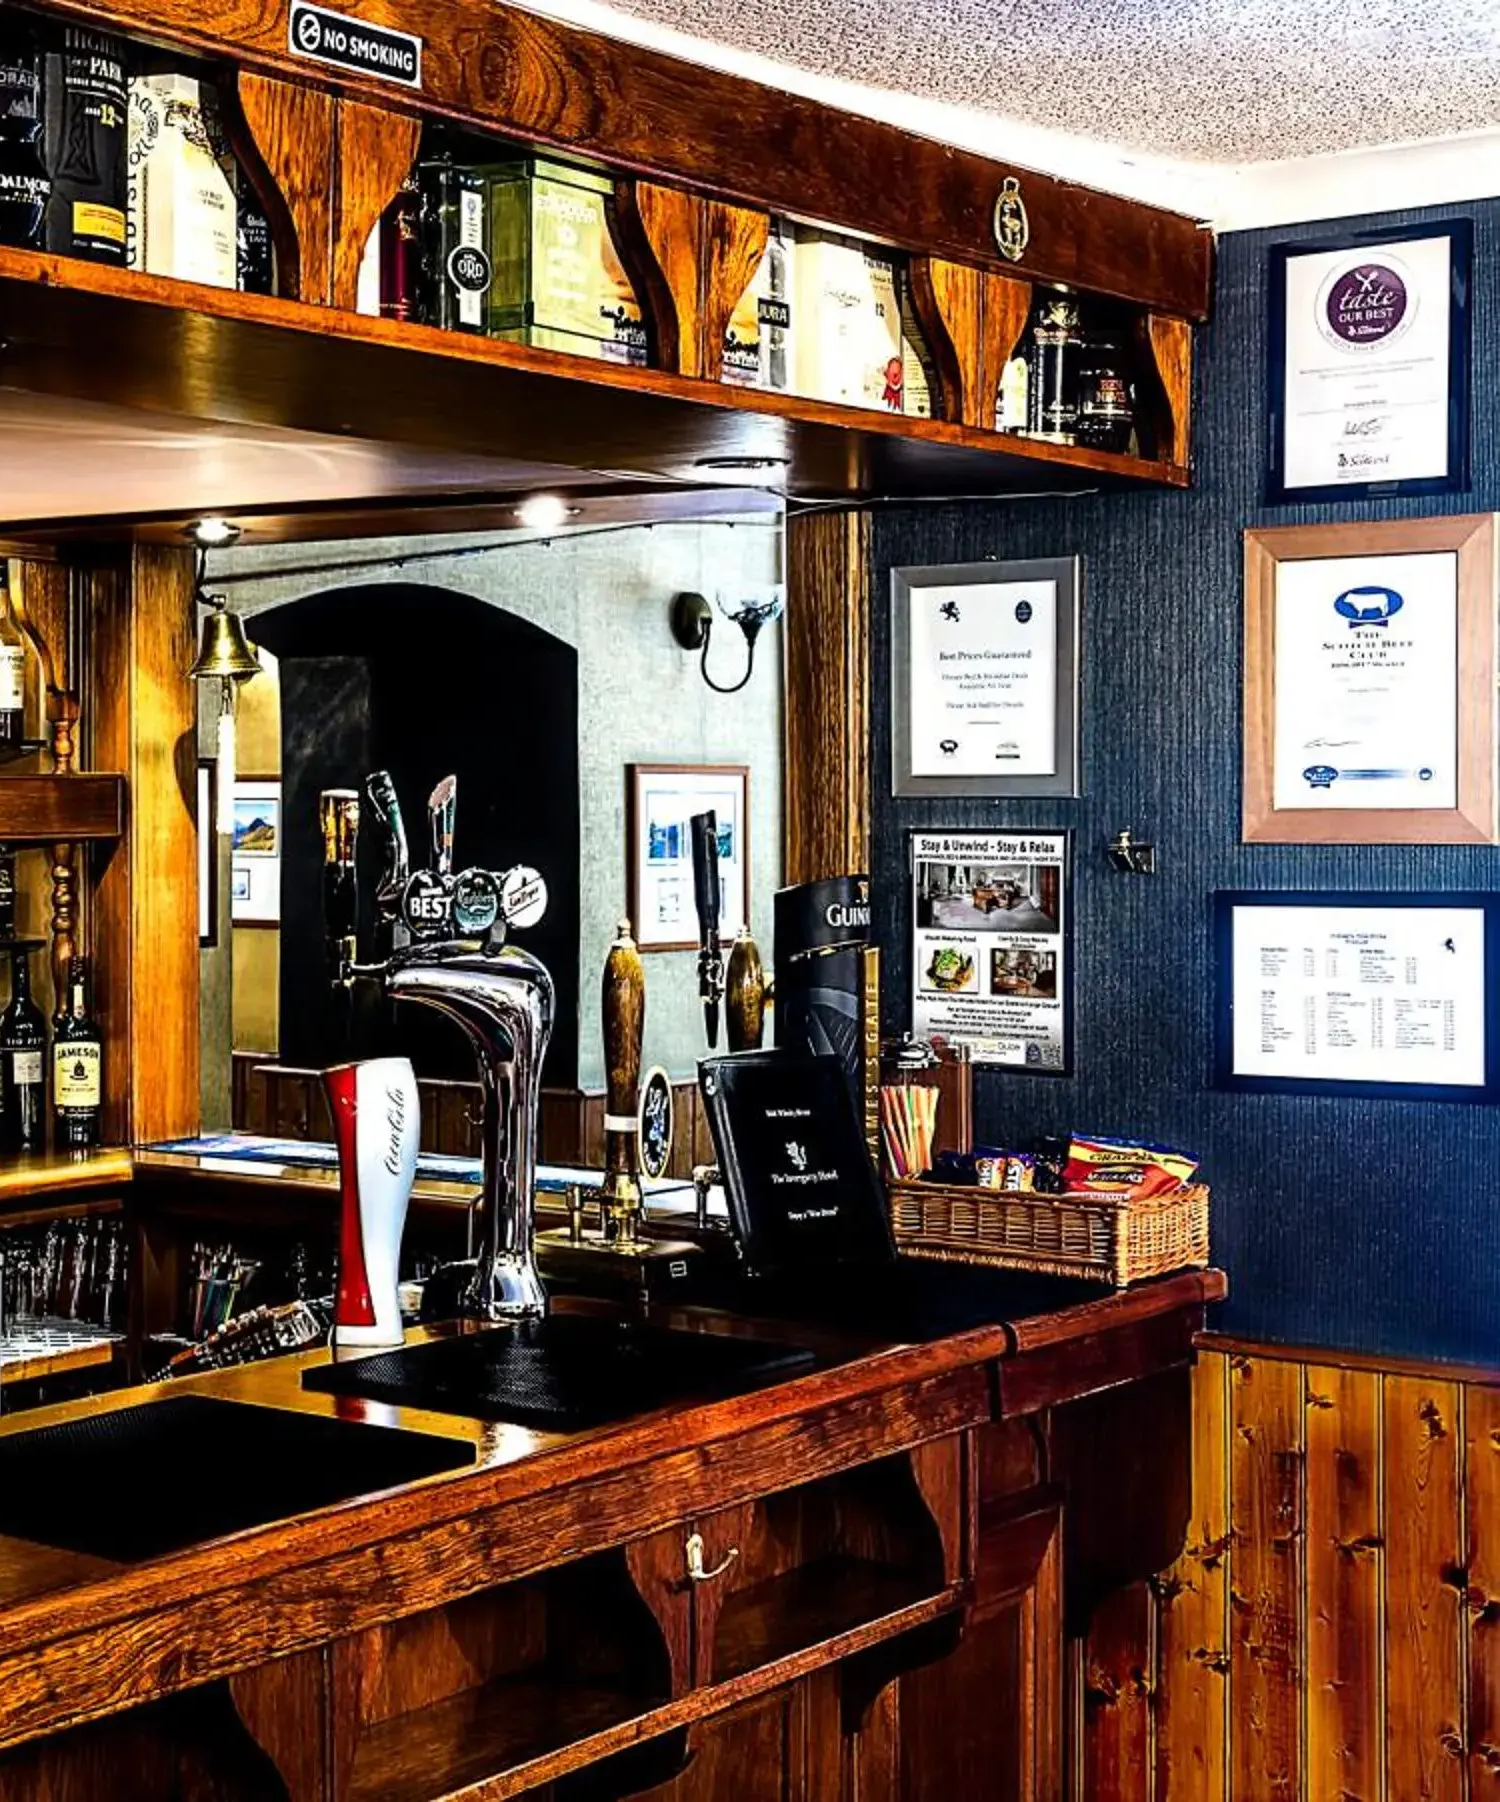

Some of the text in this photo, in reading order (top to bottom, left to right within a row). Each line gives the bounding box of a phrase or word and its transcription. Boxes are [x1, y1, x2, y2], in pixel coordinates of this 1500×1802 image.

[323, 27, 414, 72] NO SMOKING
[101, 103, 115, 128] 12
[458, 259, 484, 279] ORD
[1340, 286, 1398, 310] taste
[1339, 307, 1395, 323] OUR BEST
[921, 839, 941, 853] Stay
[943, 839, 951, 851] &
[951, 840, 989, 853] Unwind
[997, 840, 1019, 854] Stay
[1020, 841, 1027, 853] &
[409, 897, 451, 918] BEST
[866, 983, 881, 1042] GATE
[57, 1047, 98, 1060] JAMESON
